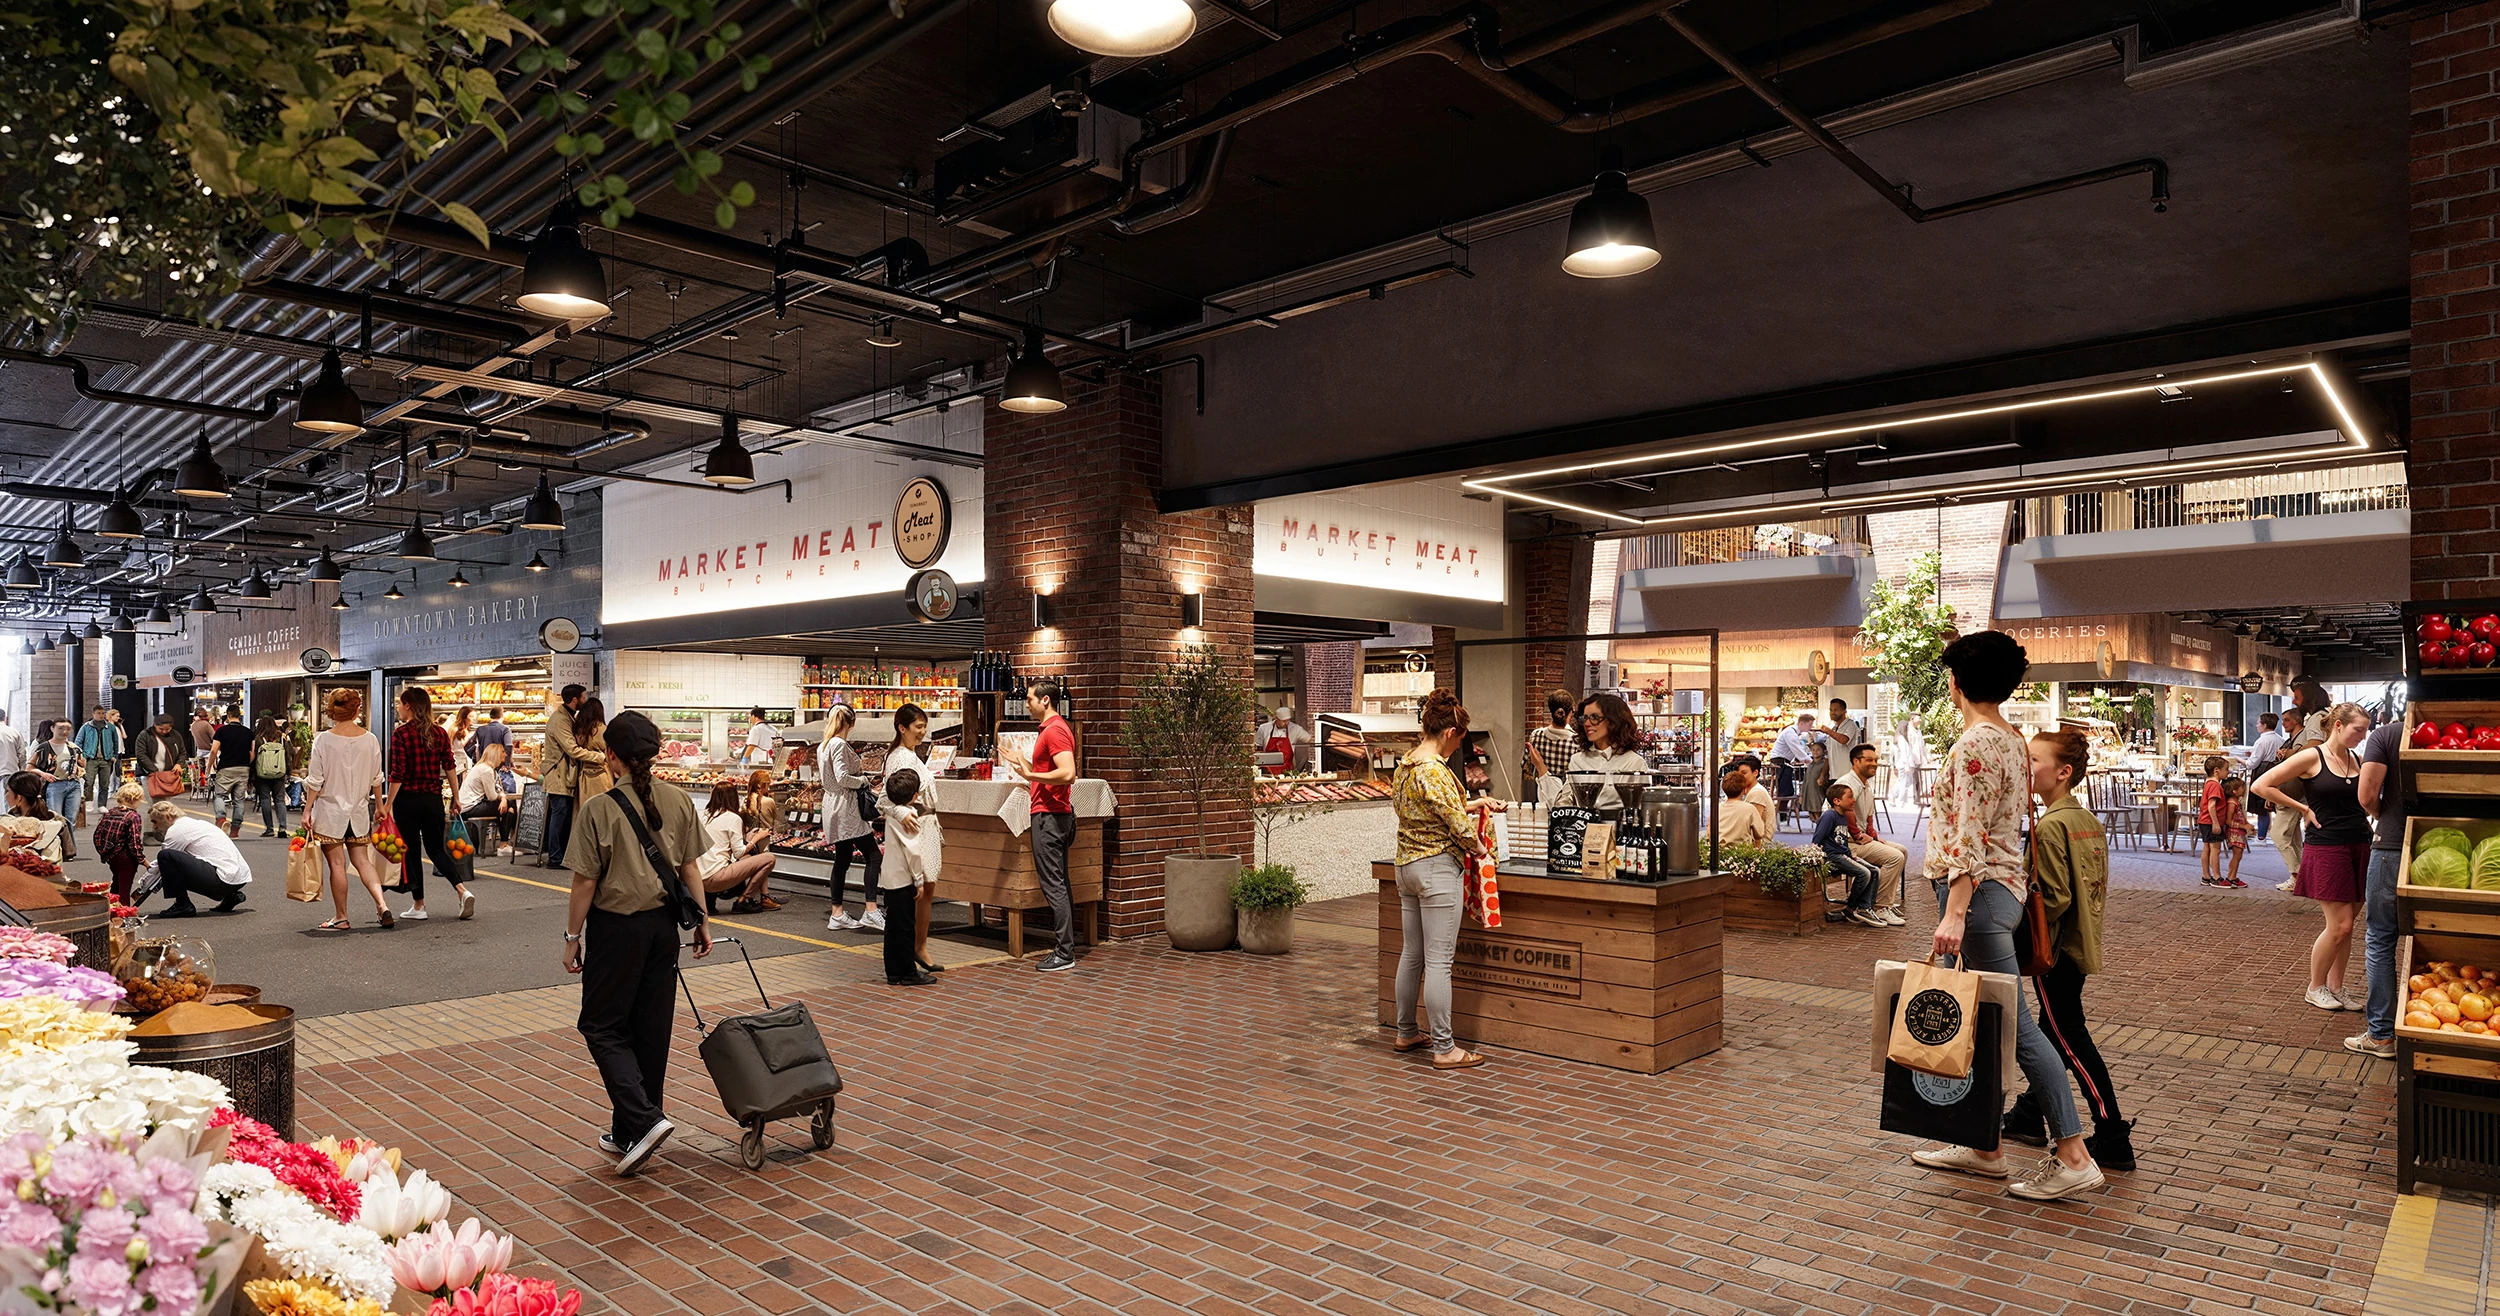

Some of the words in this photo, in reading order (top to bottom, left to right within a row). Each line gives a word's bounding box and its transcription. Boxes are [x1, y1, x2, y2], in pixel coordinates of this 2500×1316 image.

[903, 511, 934, 534] Meat
[906, 532, 932, 543] SHOP
[1282, 519, 1396, 553] MARKET
[1416, 539, 1478, 565] MEAT
[658, 541, 768, 582] MARKET
[792, 520, 883, 561] MEAT
[1280, 542, 1480, 578] BUTCHER
[673, 560, 860, 596] BUTCHER
[374, 608, 456, 639] DOWNTOWN
[468, 595, 540, 627] BAKERY
[228, 633, 262, 650] CENTRAL
[267, 626, 300, 644] COFFEE
[1993, 624, 2107, 640] OCERIES
[236, 646, 260, 657] MARKET
[264, 642, 290, 653] SQUARE
[626, 681, 647, 689] FAST
[658, 682, 683, 690] FRESH
[696, 694, 709, 702] GO
[1455, 941, 1510, 962] MARKET
[1513, 948, 1571, 970] COFFEE
[1942, 1081, 1967, 1100] ARKET
